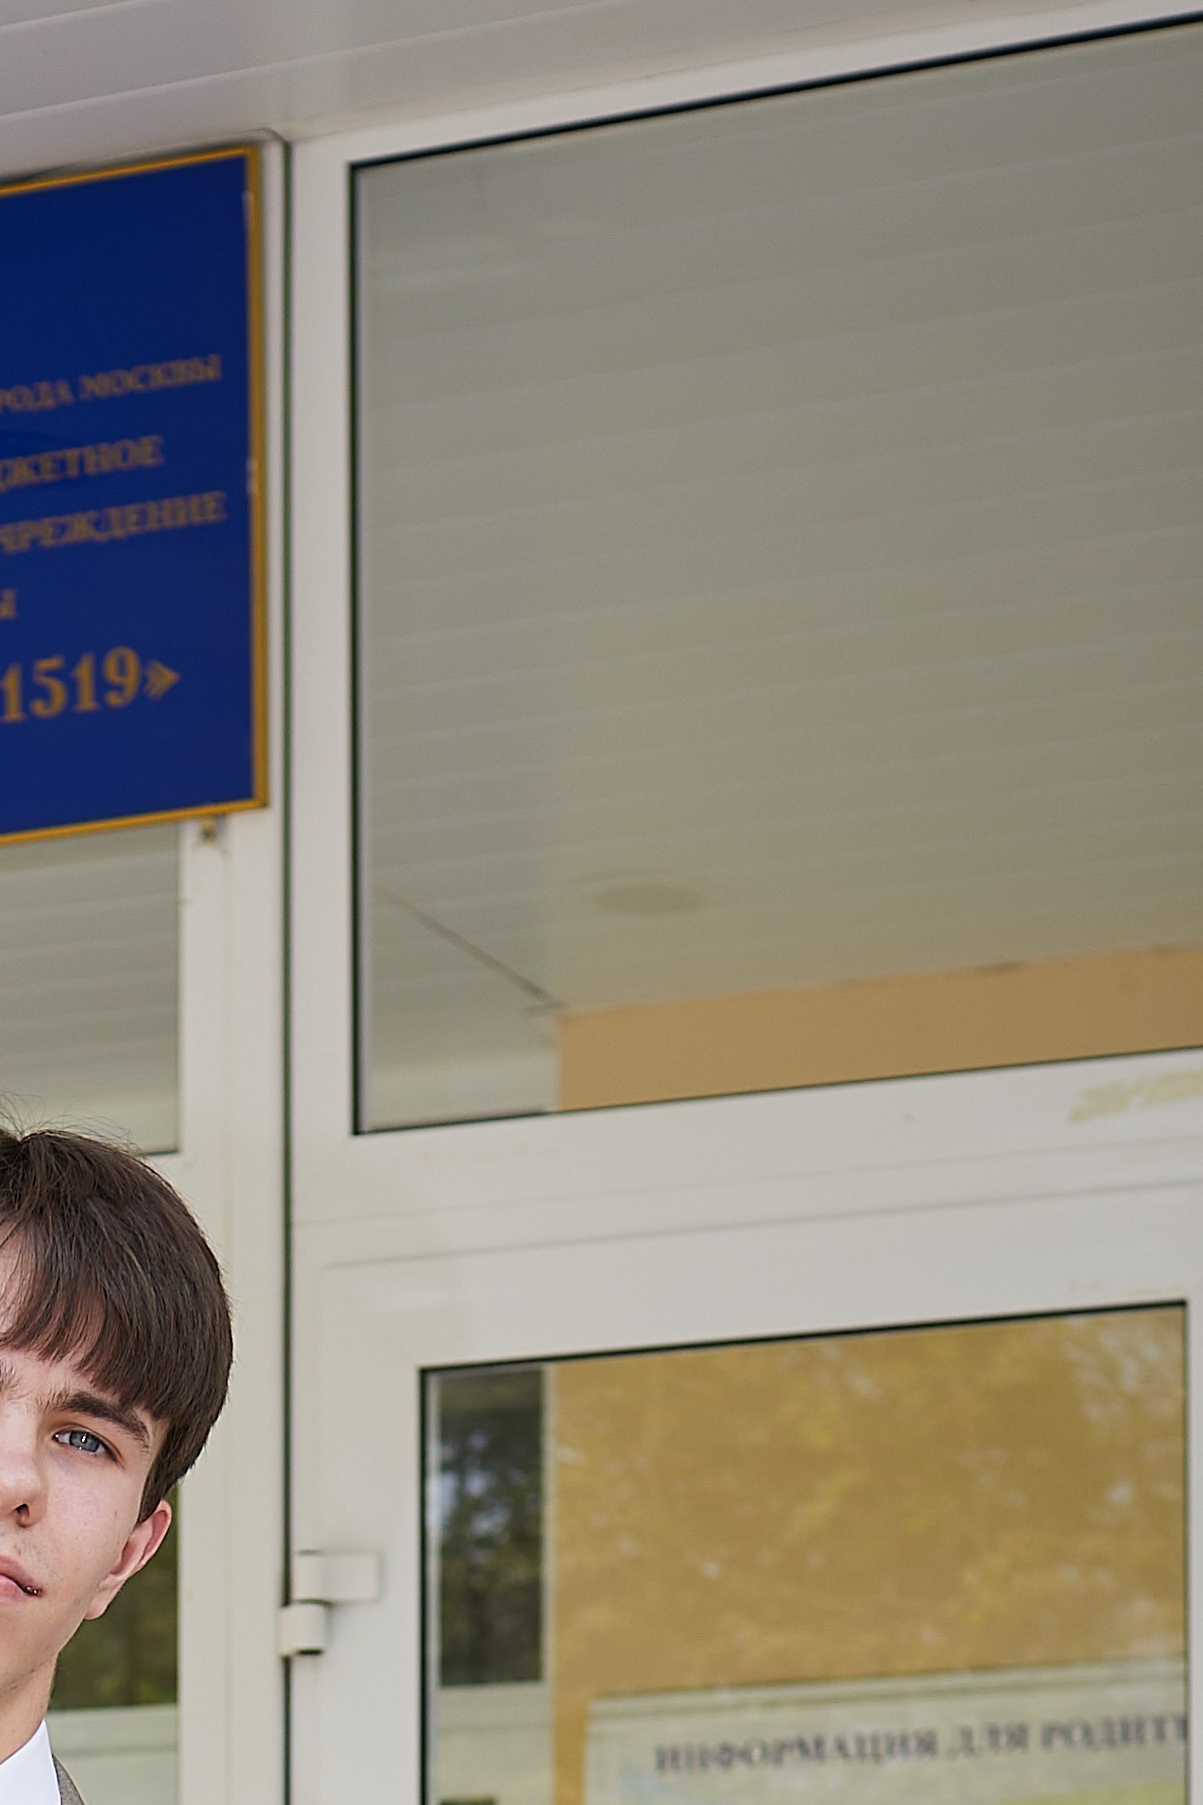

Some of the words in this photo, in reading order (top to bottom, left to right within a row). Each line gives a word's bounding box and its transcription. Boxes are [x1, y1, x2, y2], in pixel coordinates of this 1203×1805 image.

[79, 354, 221, 399] МОСКВЫ
[654, 1727, 939, 1773] ИНФОРМАЦИЯ
[946, 1720, 1030, 1762] ДЛЯ
